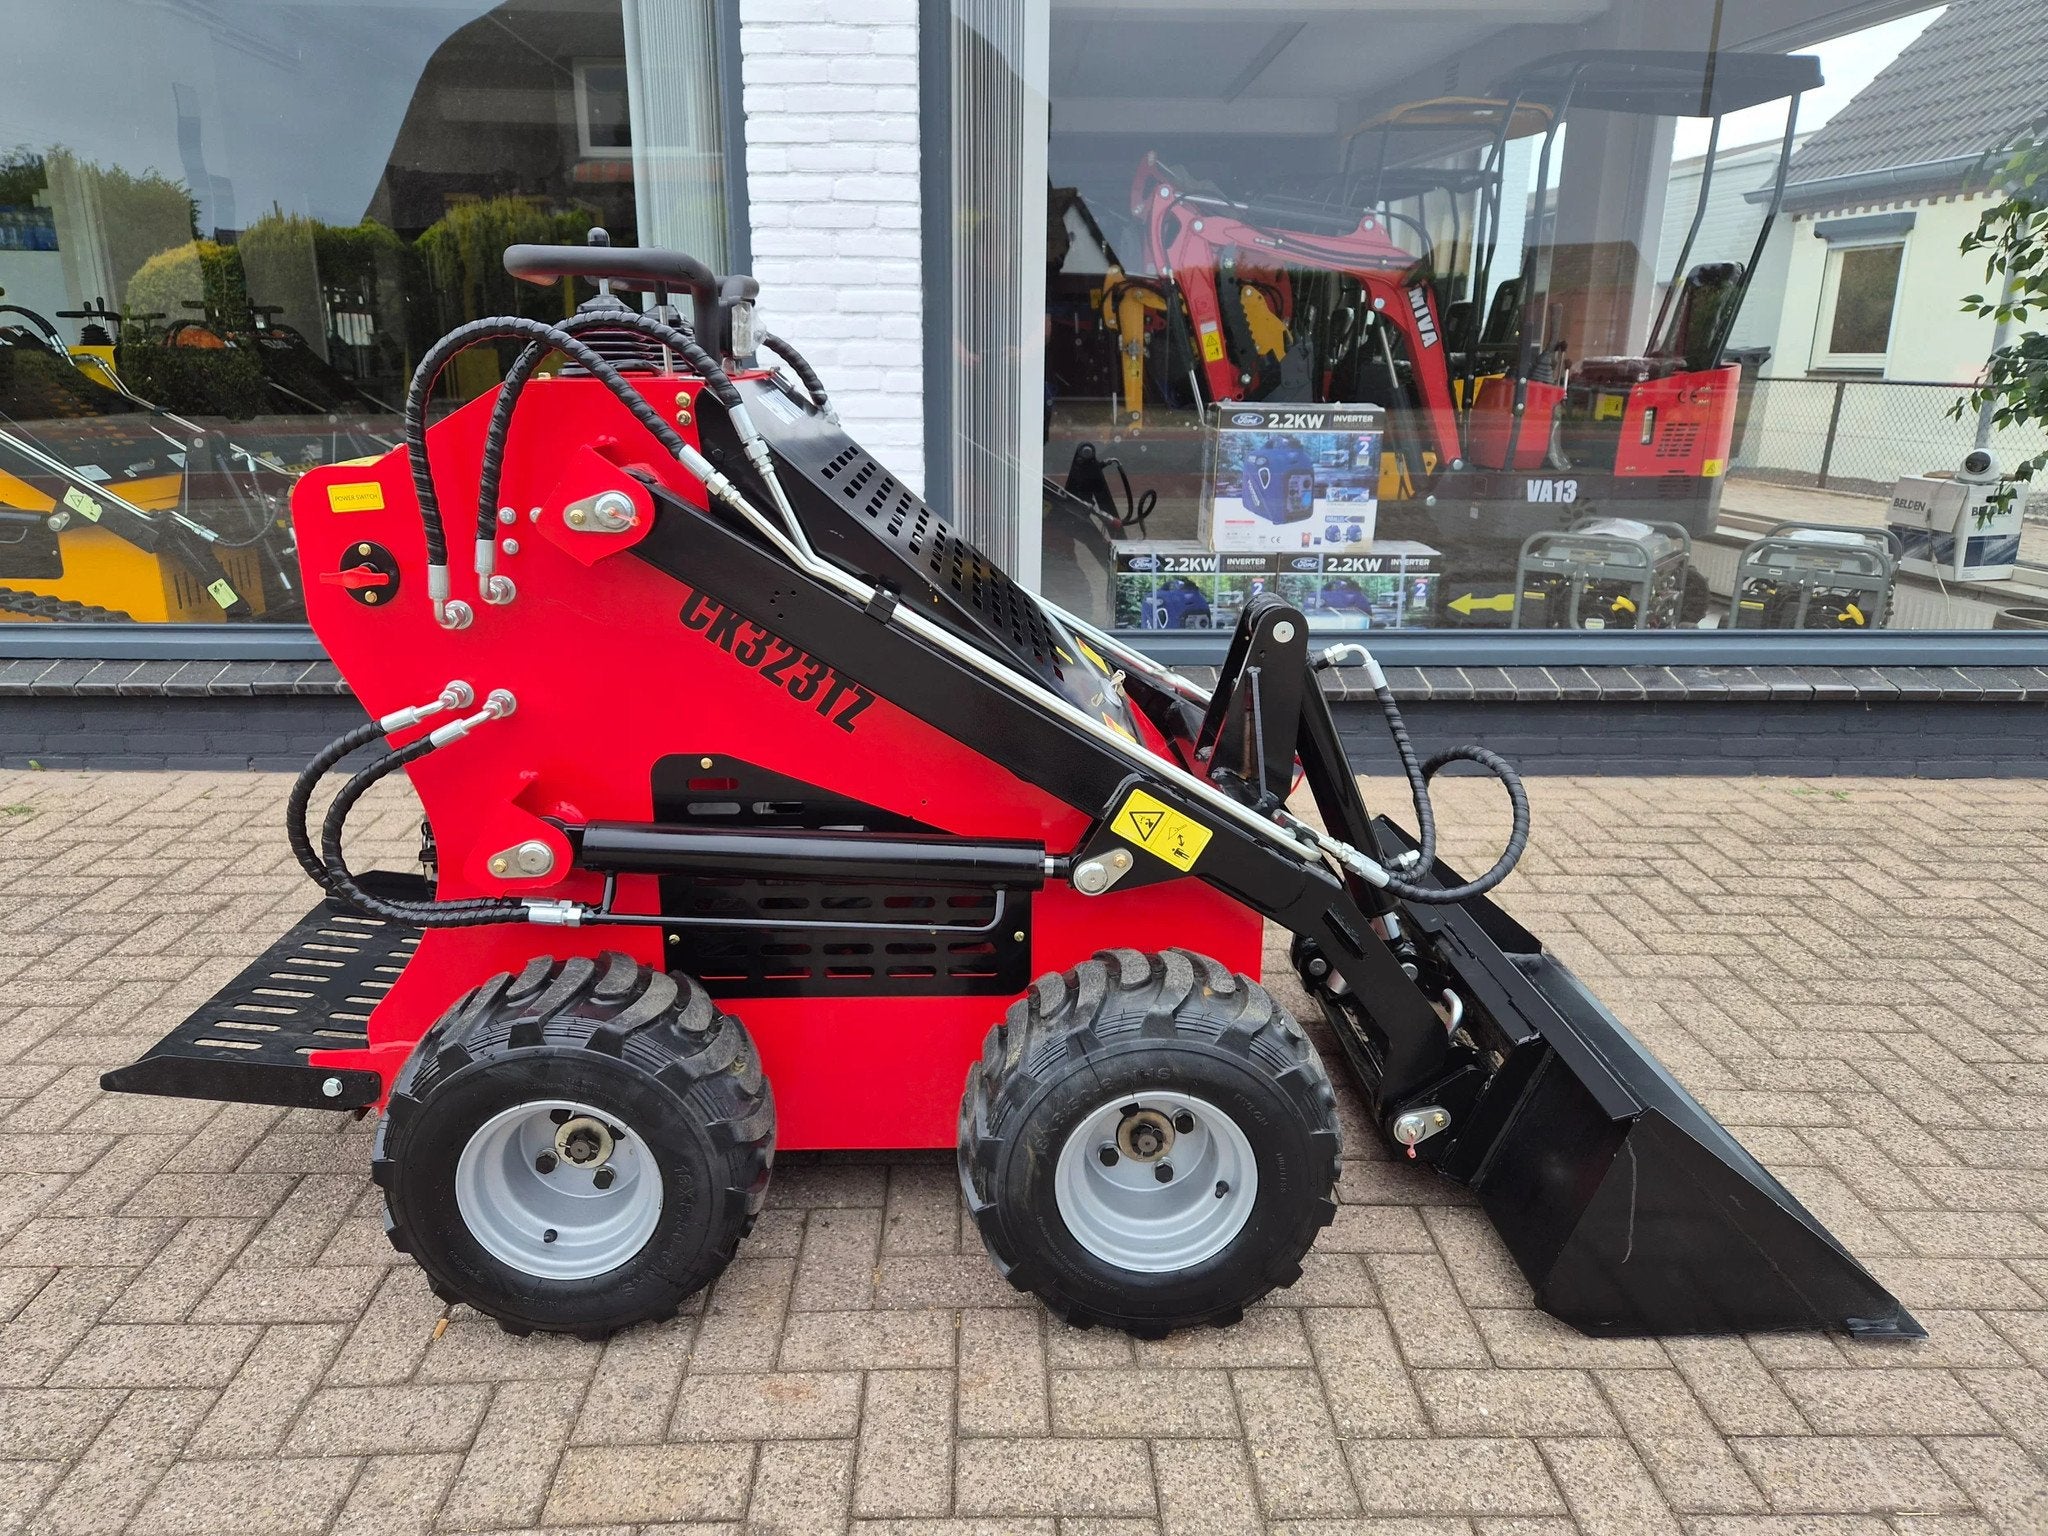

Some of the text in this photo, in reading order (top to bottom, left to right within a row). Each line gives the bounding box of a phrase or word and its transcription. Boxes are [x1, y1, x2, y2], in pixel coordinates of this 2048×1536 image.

[1408, 286, 1438, 349] MIVA
[1235, 413, 1325, 429] Ford 2.2KW
[1333, 414, 1374, 423] INVERTER
[1359, 441, 1369, 455] 2
[355, 493, 378, 501] SWITCH
[1526, 479, 1578, 503] VA13
[1893, 497, 1926, 511] BELDEN
[1164, 557, 1219, 572] 2.2KW
[1226, 557, 1266, 565] INVERTER
[1295, 557, 1383, 572] Ford 2.2KW
[1391, 558, 1430, 566] INERTER
[1415, 583, 1426, 597] 2
[678, 589, 877, 735] CK323TZ
